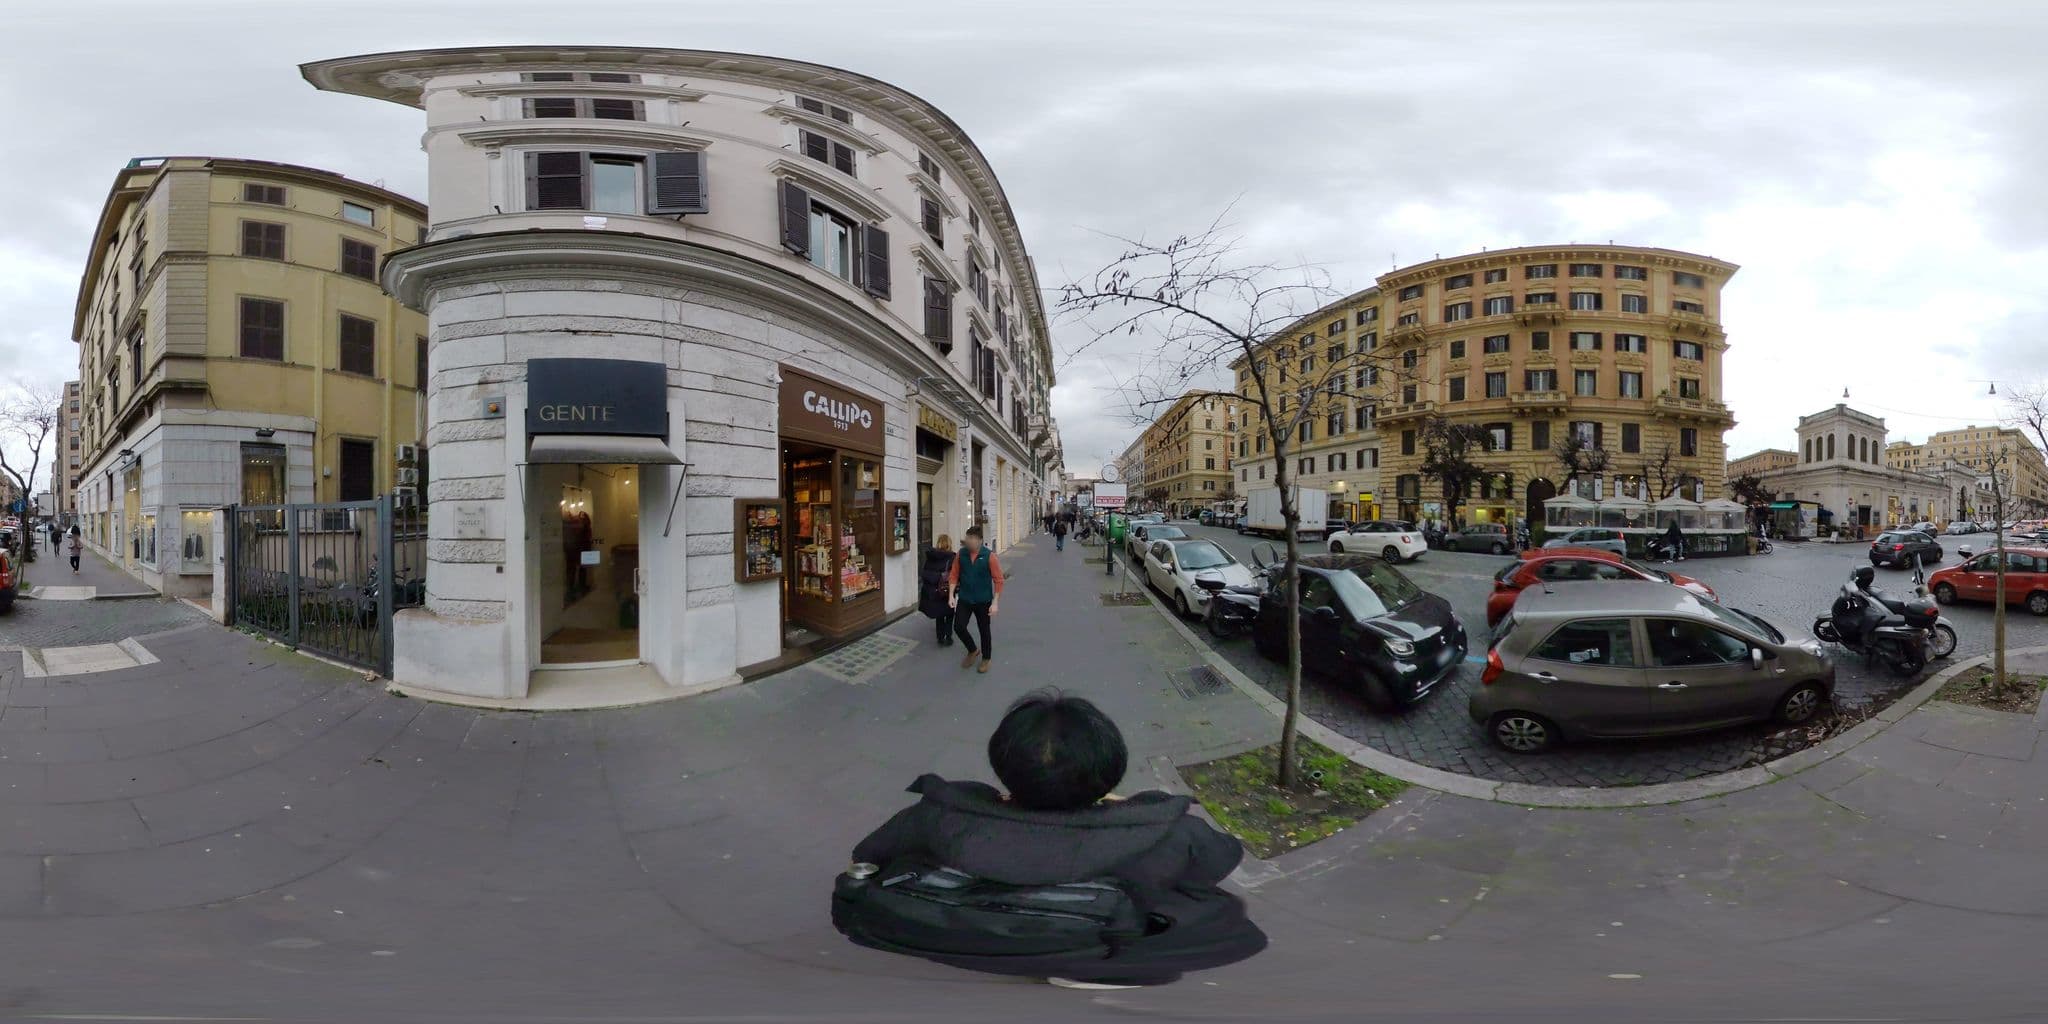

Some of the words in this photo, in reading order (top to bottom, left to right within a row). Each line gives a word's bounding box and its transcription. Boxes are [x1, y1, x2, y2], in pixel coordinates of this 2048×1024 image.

[539, 404, 617, 421] GENTE
[803, 390, 873, 429] CALLIPO
[832, 419, 849, 431] 1913
